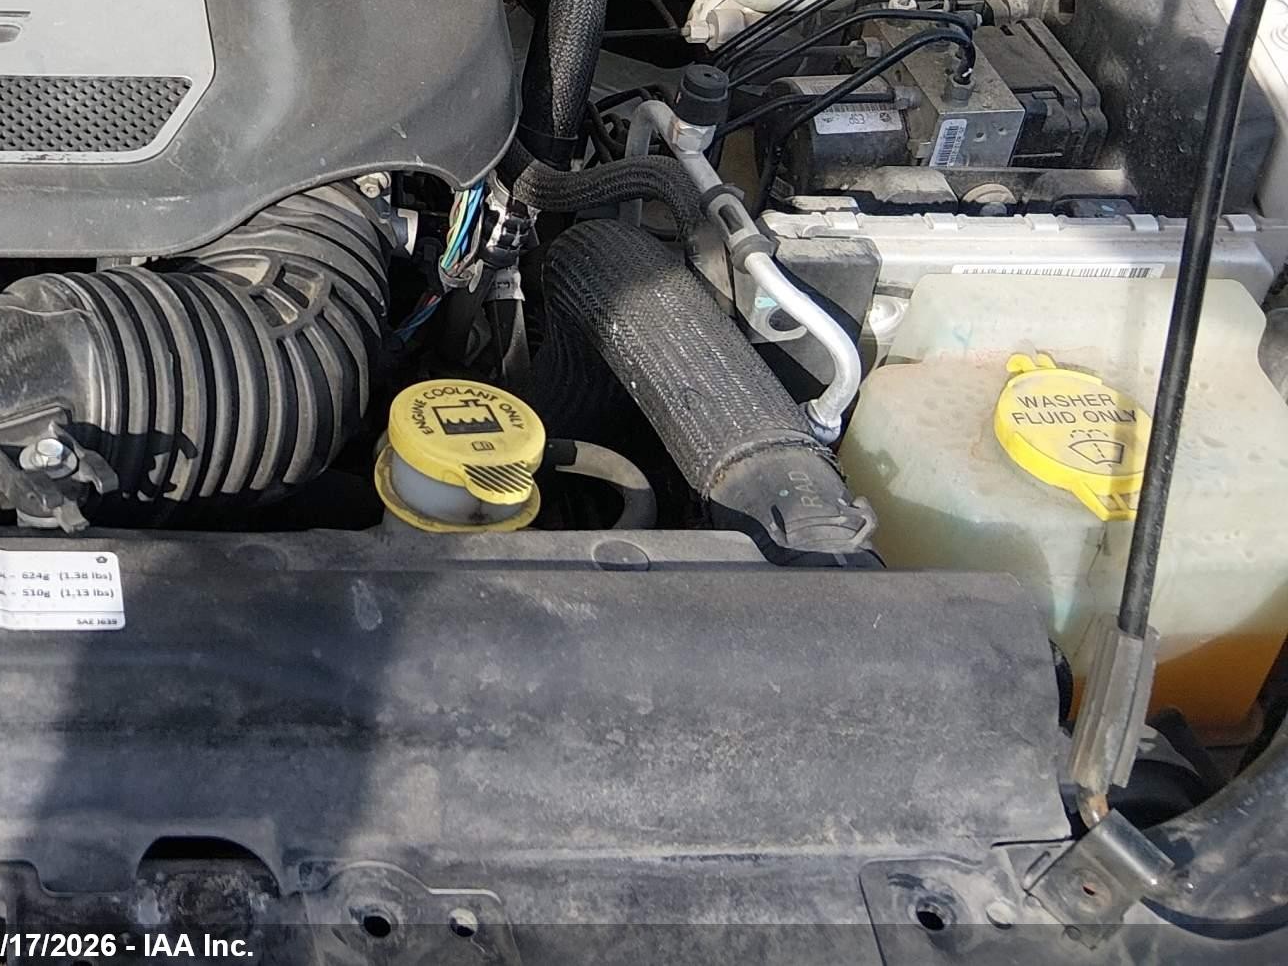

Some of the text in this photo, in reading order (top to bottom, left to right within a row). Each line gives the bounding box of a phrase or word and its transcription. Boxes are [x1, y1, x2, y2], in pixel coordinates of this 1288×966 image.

[1017, 393, 1116, 409] WASHER
[411, 386, 525, 435] ENGINE COOLANT ONLY
[1011, 409, 1138, 425] FLUID ONLY
[787, 471, 824, 509] RAD
[21, 572, 51, 581] 624g
[58, 571, 89, 581] (1.38
[91, 571, 113, 581] lbs)
[21, 589, 51, 598] 510g
[92, 588, 115, 598] lbs)
